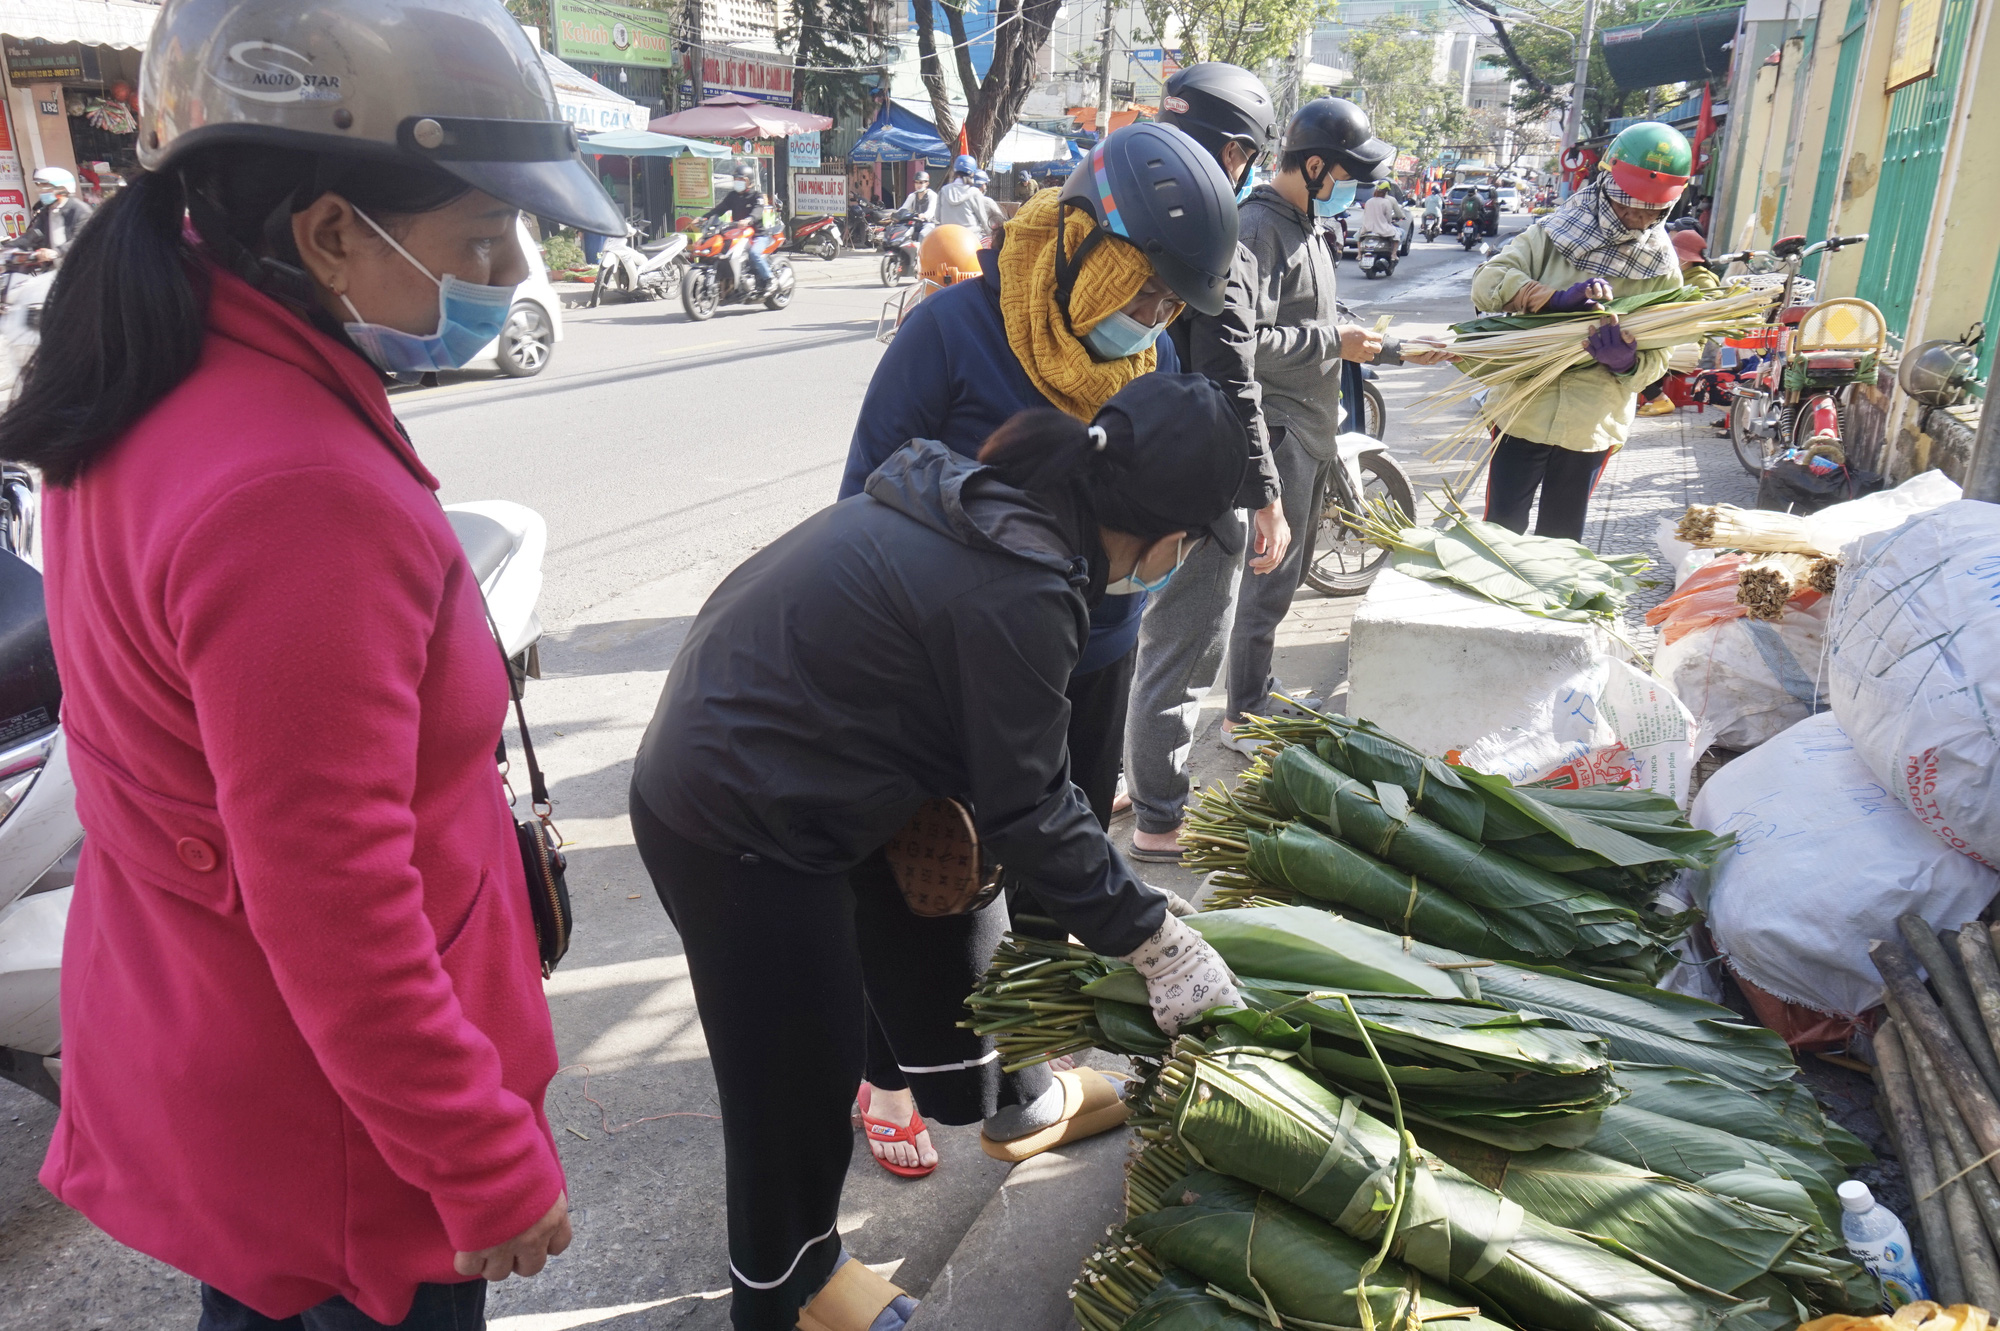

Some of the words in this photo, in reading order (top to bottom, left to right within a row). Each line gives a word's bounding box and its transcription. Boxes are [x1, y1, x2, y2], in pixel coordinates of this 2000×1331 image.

[561, 20, 609, 45] Kebab
[631, 29, 667, 52] Nova
[253, 73, 294, 85] MOTO
[303, 75, 340, 88] STAR
[41, 102, 59, 113] 182
[559, 104, 595, 127] TRÁI
[798, 178, 808, 195] VĂN
[808, 177, 824, 195] PHÒNG
[825, 177, 837, 198] LUẬT
[837, 179, 845, 196] SƯ
[1927, 799, 1945, 821] TY
